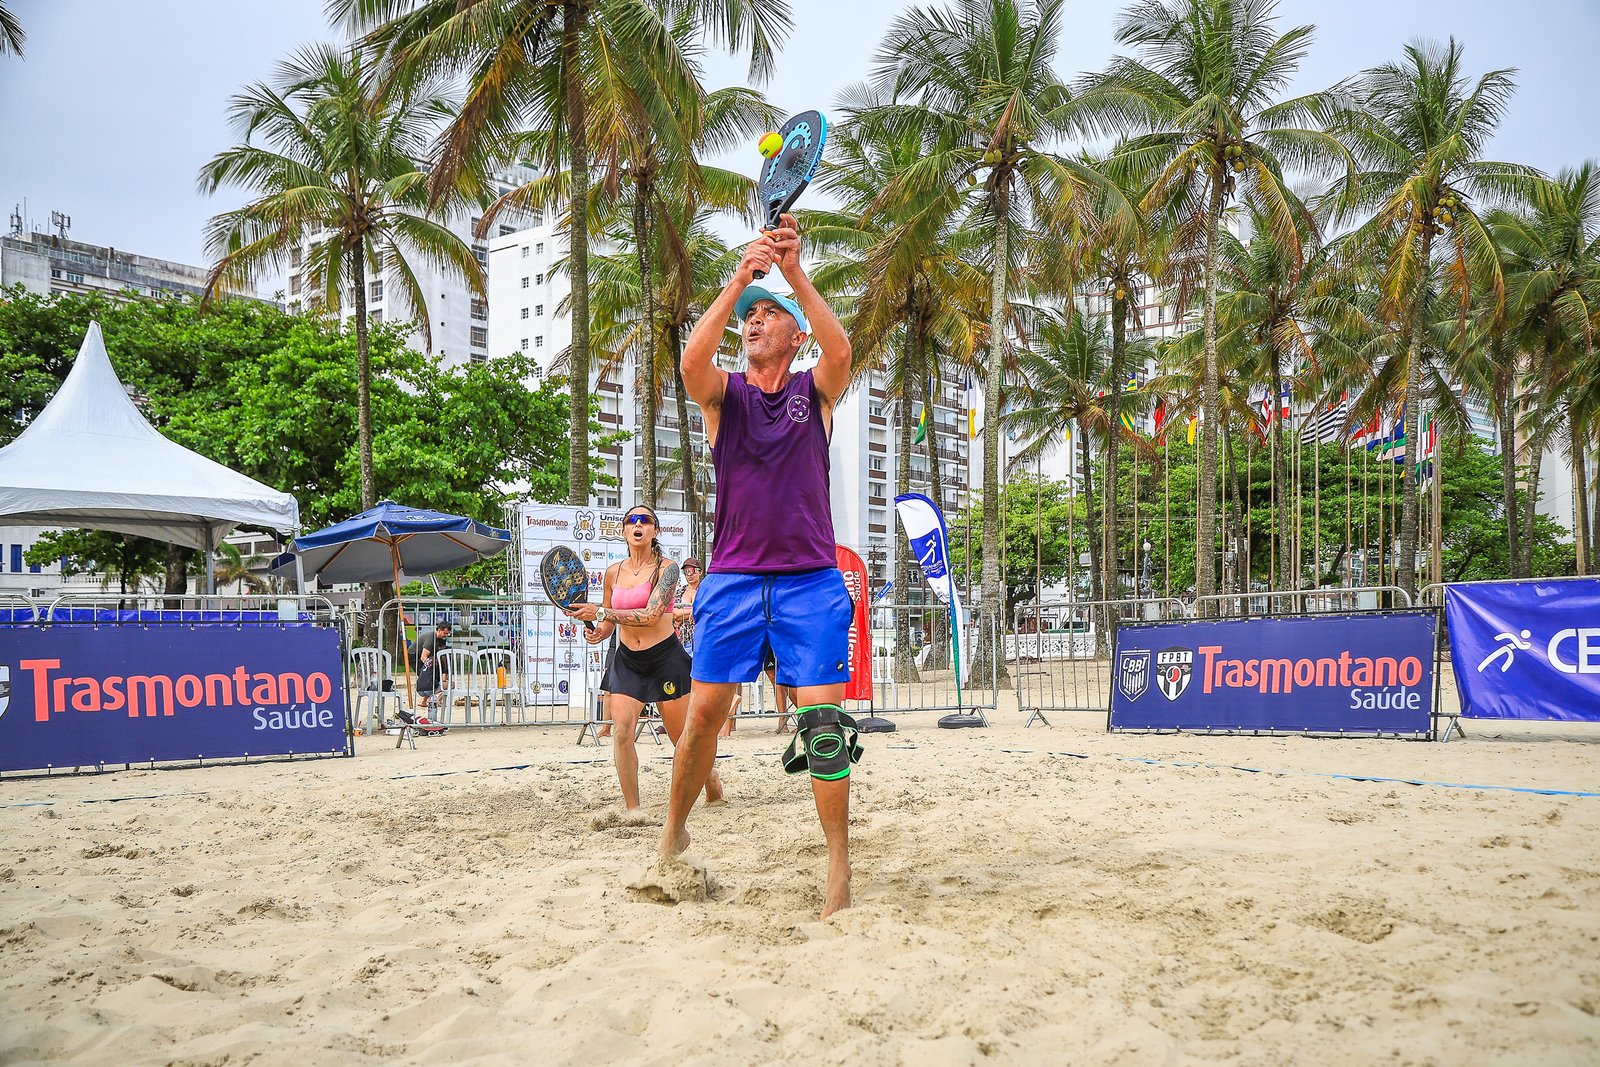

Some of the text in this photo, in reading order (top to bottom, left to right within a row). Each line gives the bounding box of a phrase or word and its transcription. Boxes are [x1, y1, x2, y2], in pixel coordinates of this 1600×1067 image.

[526, 516, 568, 526] Trasmontano
[599, 528, 624, 536] TEN
[1122, 656, 1149, 673] CBBT
[1161, 652, 1188, 663] FPBT
[1198, 645, 1423, 694] Trasmontano
[19, 658, 332, 722] Trasmontano
[1350, 685, 1421, 710] Saúde
[253, 703, 334, 731] Saúde
